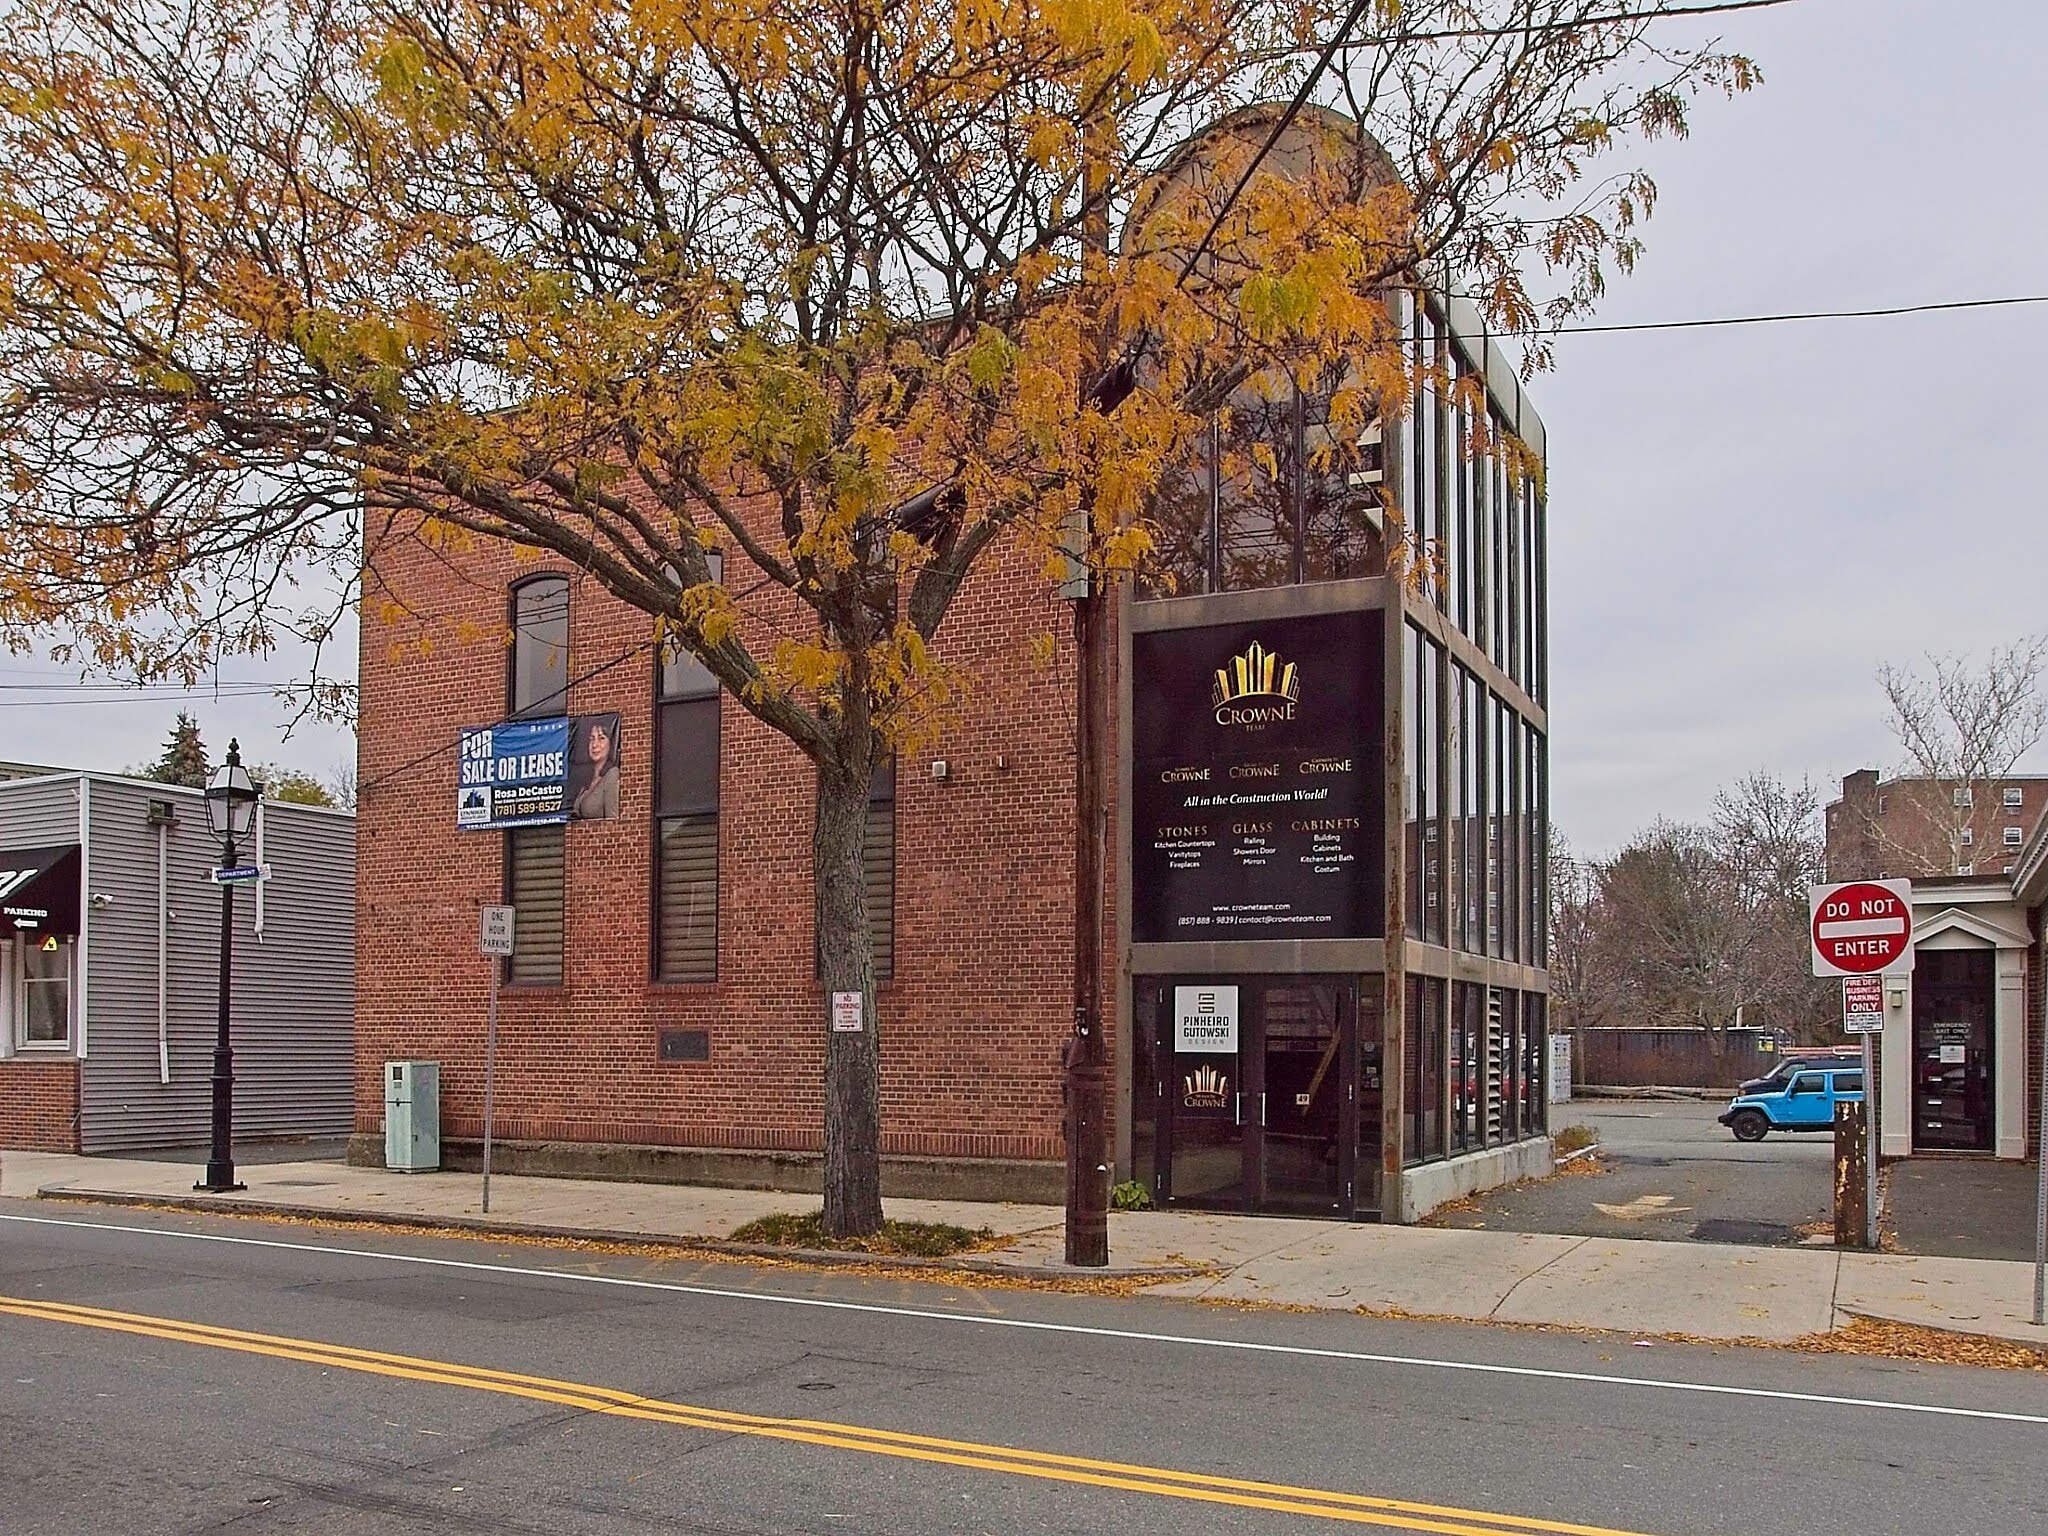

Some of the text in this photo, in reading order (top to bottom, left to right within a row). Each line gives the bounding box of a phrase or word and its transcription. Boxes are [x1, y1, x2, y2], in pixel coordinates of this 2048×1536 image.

[1215, 702, 1296, 726] CROWNE
[462, 729, 493, 759] FOR
[462, 752, 564, 784] SALE OR LEASE
[1229, 764, 1280, 778] CROWNE
[1299, 759, 1353, 774] CROWNE
[1161, 768, 1212, 783] CROWNE
[494, 785, 563, 799] Rosa DeCastro
[1183, 788, 1329, 807] All in the Construction World!
[494, 801, 562, 817] (781) 589-8527
[1232, 821, 1273, 834] GLASS
[1291, 818, 1360, 831] CABINETS
[1158, 825, 1208, 838] STONES
[1313, 834, 1341, 842] Building
[1177, 840, 1216, 848] Countertops
[1312, 844, 1341, 852] Cabinets
[1260, 847, 1276, 855] Door
[1243, 858, 1266, 866] Mirrors
[1300, 853, 1354, 863] Kitchen and Bath
[1169, 861, 1200, 869] Fireplaces
[218, 869, 256, 878] DEPARTMENT
[3, 907, 48, 917] PARKING
[1231, 903, 1291, 911] crowneteam.com
[1826, 899, 1895, 918] DO NOT
[492, 911, 504, 921] ONE
[489, 925, 505, 935] HOUR
[483, 938, 510, 949] PARKING
[1834, 940, 1890, 957] ENTER
[1846, 986, 1881, 994] BUSINESS
[1848, 994, 1880, 1002] PARKING
[1851, 1003, 1877, 1012] ONLY
[1183, 1016, 1229, 1026] PINHEIRO
[1183, 1027, 1229, 1038] GUTOWSKI
[1184, 1097, 1227, 1108] CROWNE
